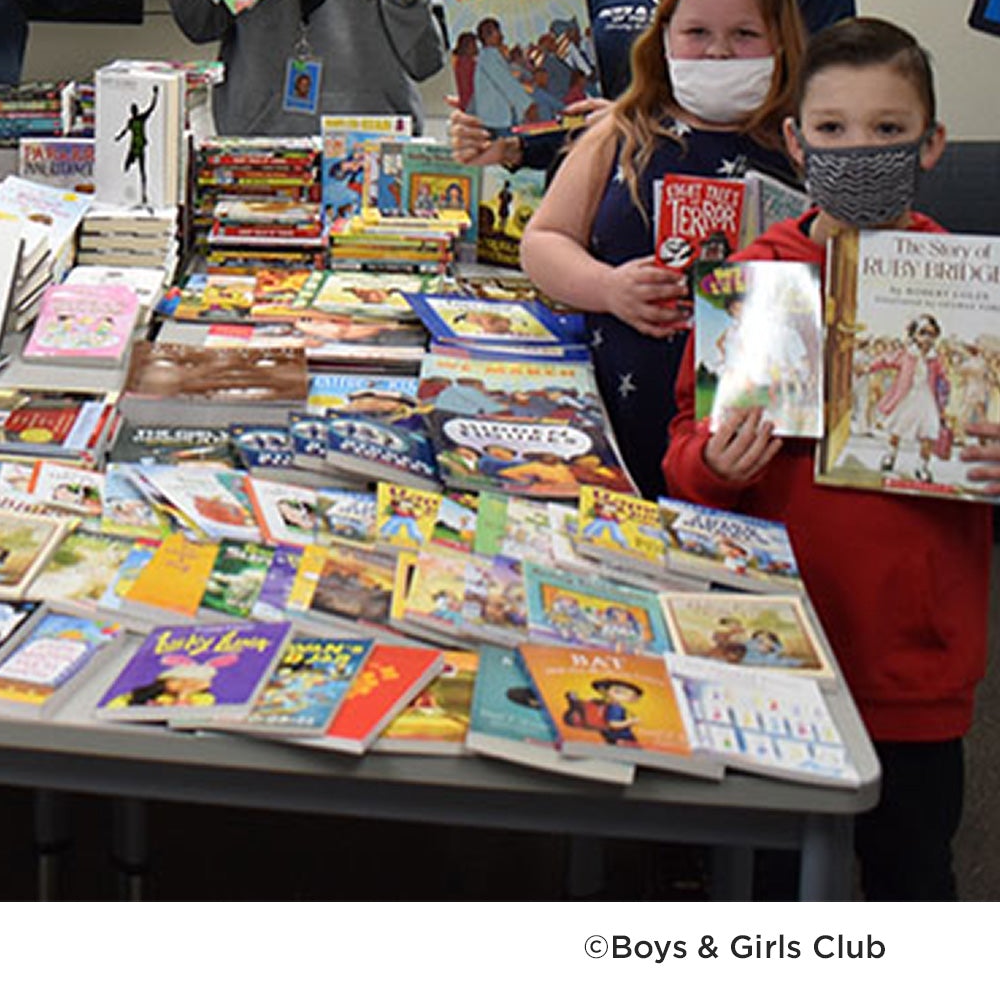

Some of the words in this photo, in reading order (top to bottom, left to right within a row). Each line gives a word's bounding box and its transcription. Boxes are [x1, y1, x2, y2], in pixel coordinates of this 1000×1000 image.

[671, 201, 737, 239] TERROR
[896, 237, 923, 255] The
[928, 240, 971, 259] Story
[973, 243, 991, 258] of
[862, 257, 918, 278] RUBY
